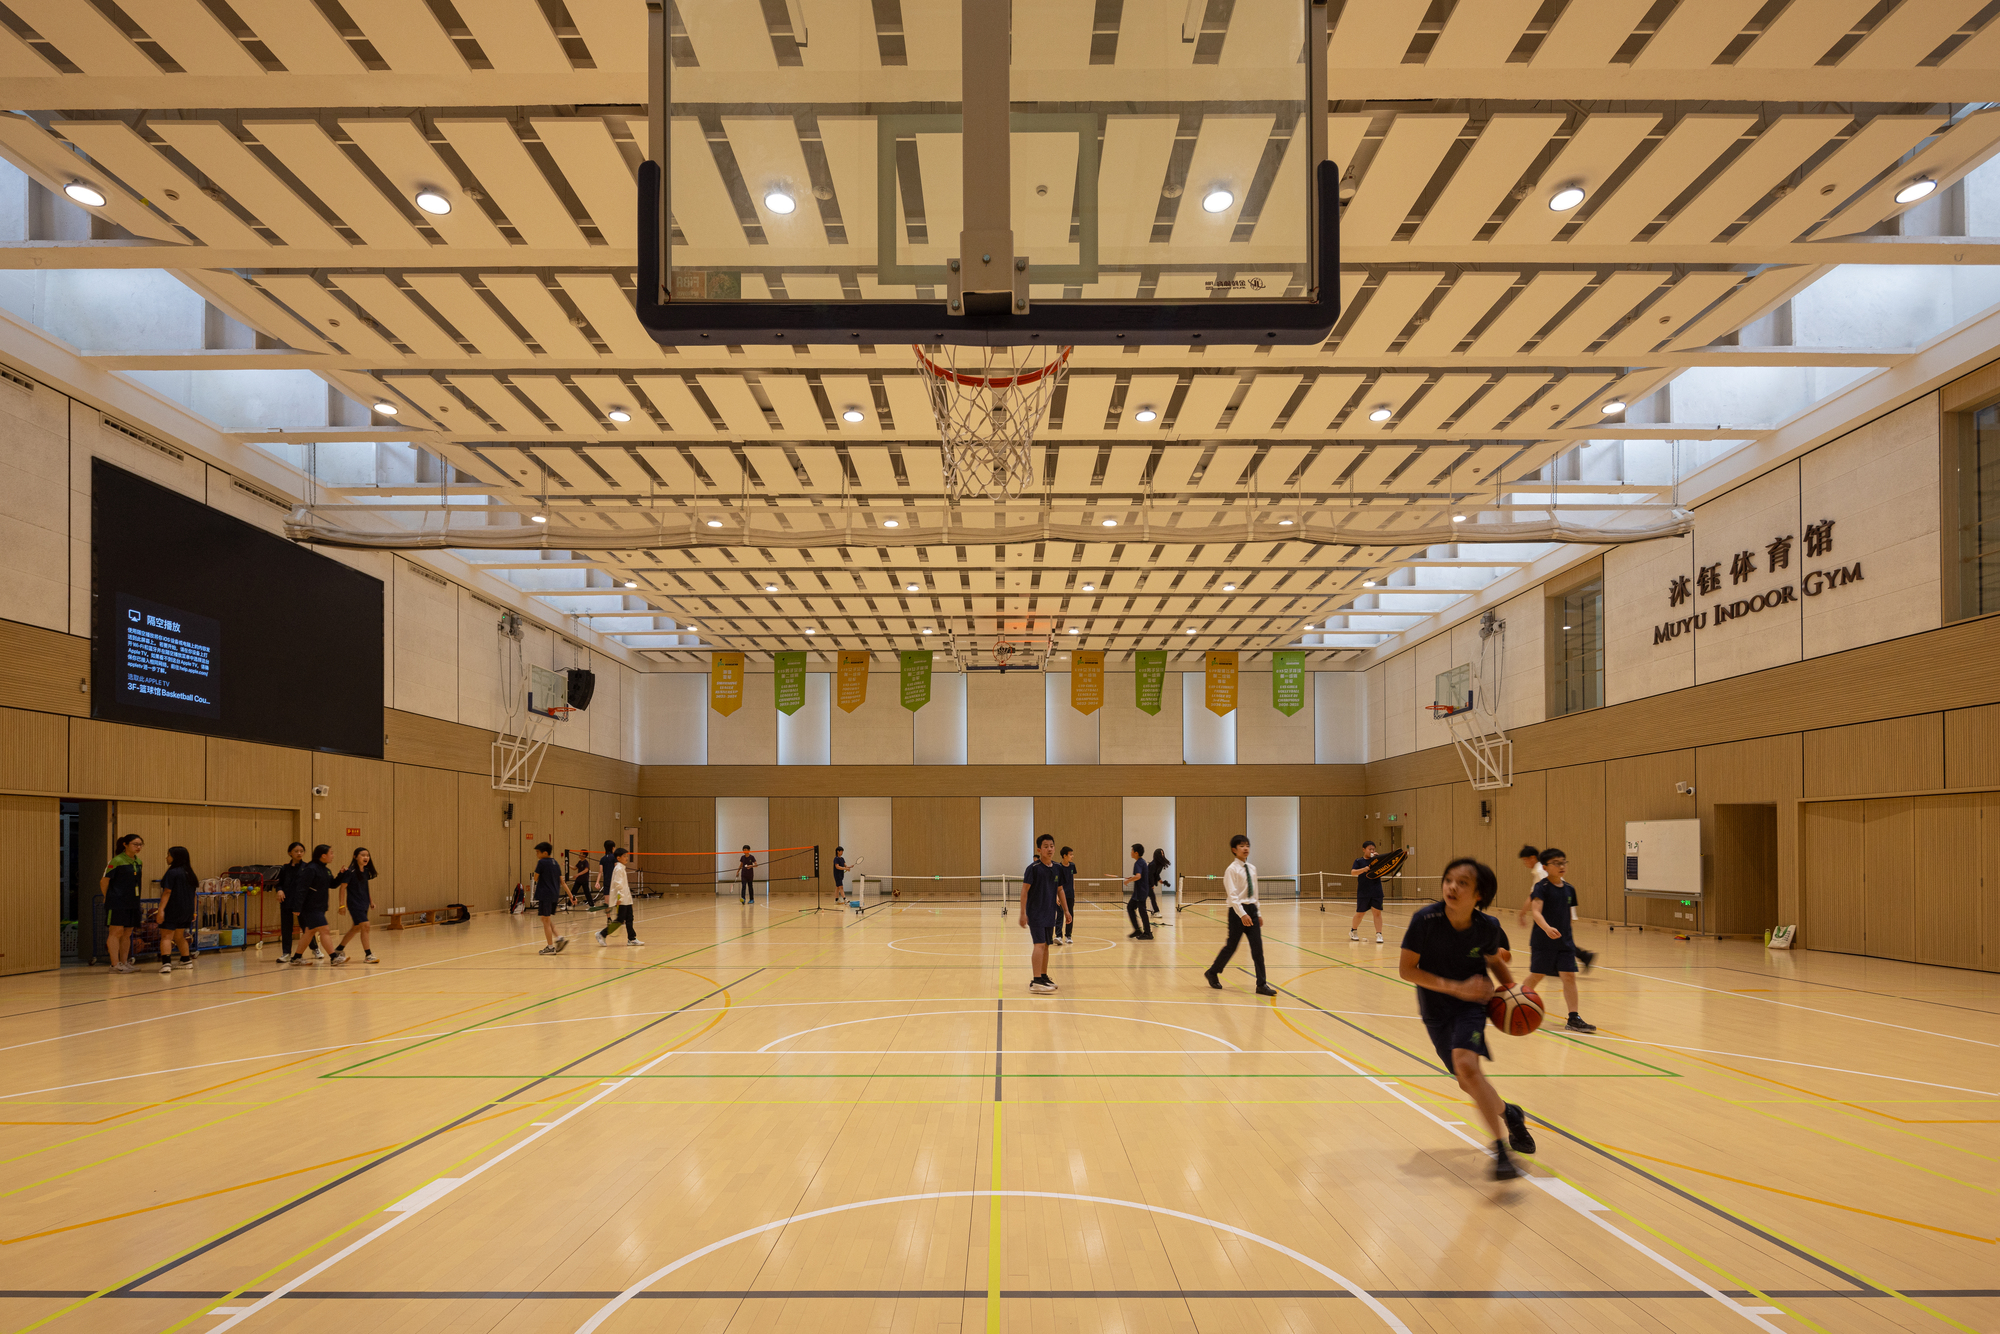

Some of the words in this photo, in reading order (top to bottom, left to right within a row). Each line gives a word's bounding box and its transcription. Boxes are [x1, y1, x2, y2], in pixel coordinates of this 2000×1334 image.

[147, 615, 181, 633] 隔空播放
[161, 687, 194, 701] Basketball
